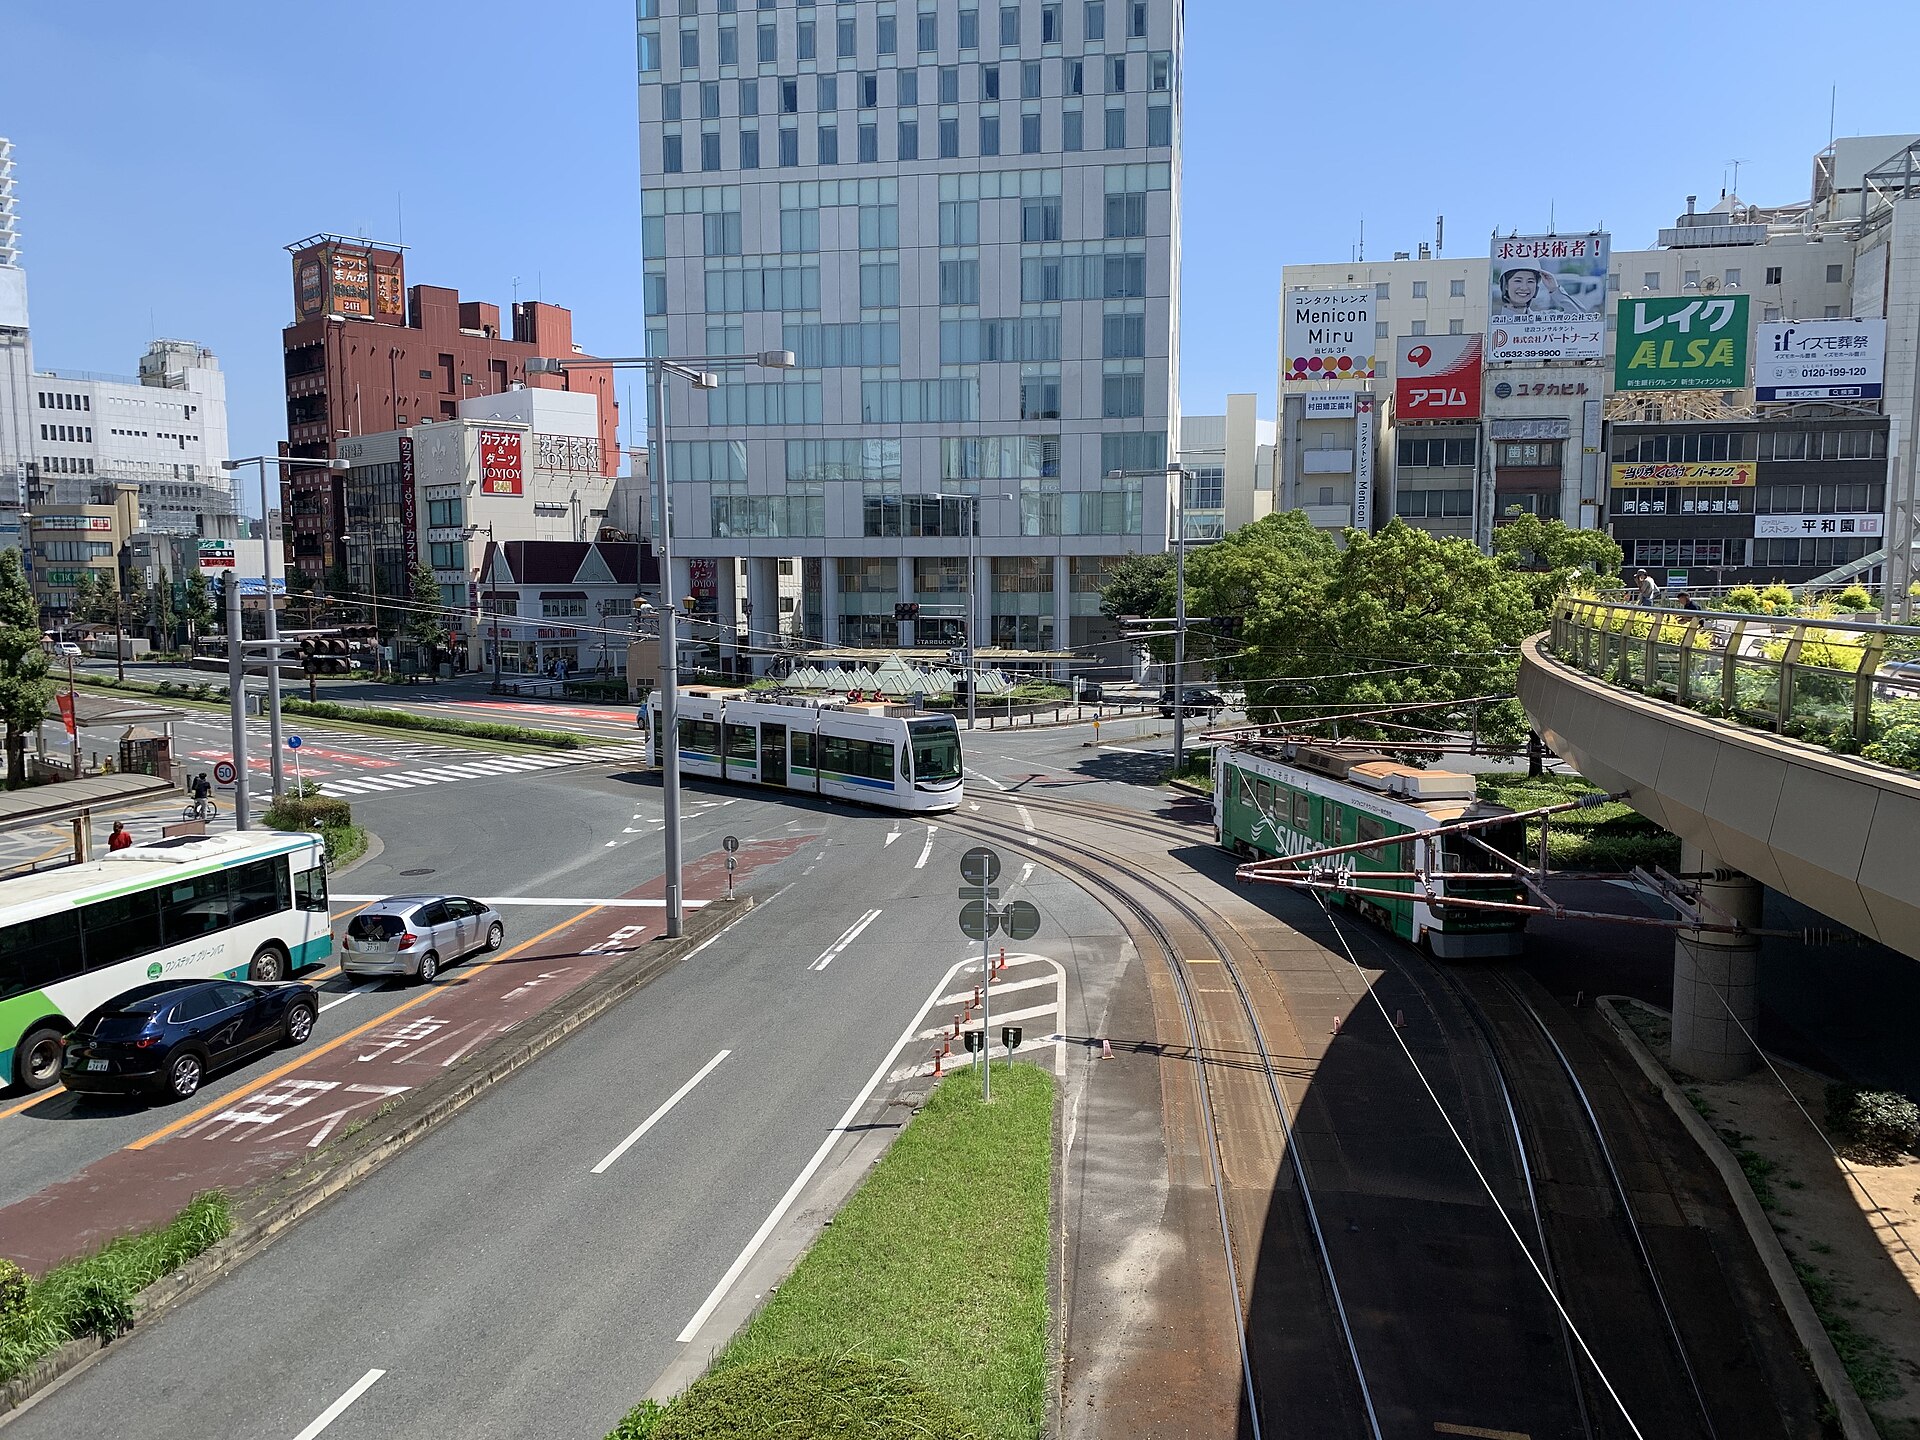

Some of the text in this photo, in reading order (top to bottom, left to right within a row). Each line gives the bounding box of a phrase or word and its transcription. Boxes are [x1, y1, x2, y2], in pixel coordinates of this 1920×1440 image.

[334, 256, 366, 270] ネット
[334, 269, 367, 283] まんが
[1295, 295, 1368, 304] コンタクトレンズ
[1296, 308, 1367, 323] Menicon
[1634, 300, 1735, 334] レイク
[1309, 329, 1353, 344] Miru
[1774, 329, 1868, 351] if イズモ葬祭
[1628, 339, 1734, 369] ALSA
[1802, 367, 1867, 378] 0120-199-120
[1517, 383, 1589, 396] ユタカビル
[1409, 388, 1466, 408] アコム
[481, 433, 520, 446] カラオケ
[540, 438, 598, 454] カラオケ
[498, 446, 505, 455] &
[1360, 422, 1368, 477] コンタクトレンズ
[1508, 445, 1538, 458] 歯科
[402, 441, 413, 481] カラオケ
[486, 454, 517, 466] ダーツ
[482, 468, 521, 480] JOYJOY
[1358, 481, 1368, 522] Menicon
[1623, 500, 1739, 512] 阿含宗 豊橋道場
[1801, 519, 1855, 533] 平和園
[1862, 521, 1875, 531] 1F
[405, 530, 417, 570] カラオケ
[690, 560, 716, 569] カラオケ
[694, 571, 713, 579] ダーツ
[691, 580, 716, 588] JOYJOY
[218, 767, 232, 779] 50
